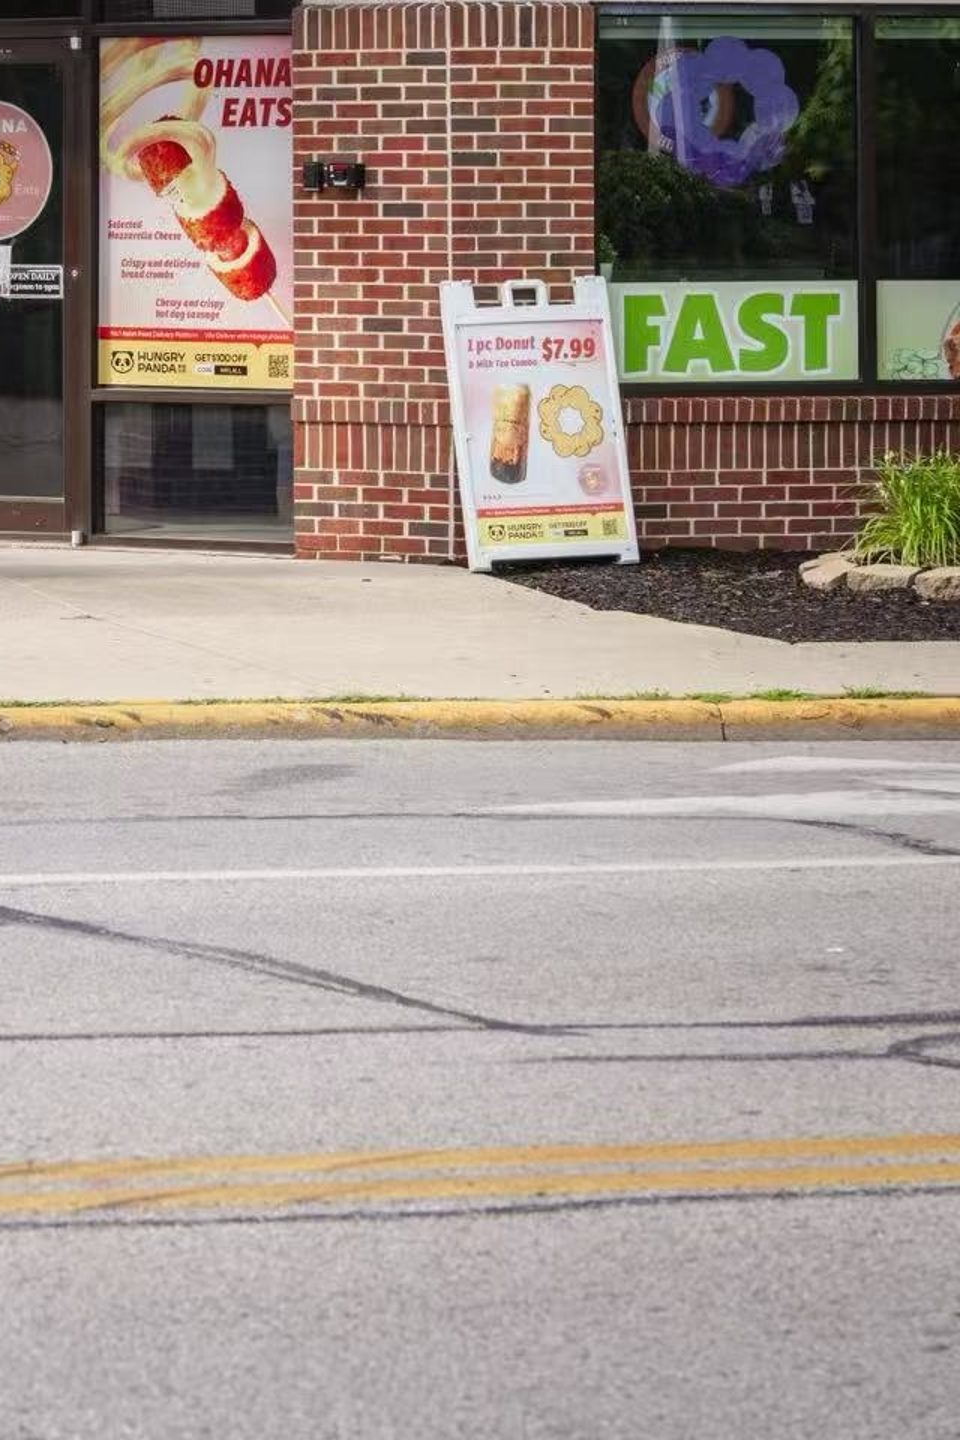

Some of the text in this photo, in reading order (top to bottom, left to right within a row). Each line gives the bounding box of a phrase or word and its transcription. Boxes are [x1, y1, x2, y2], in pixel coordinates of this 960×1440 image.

[193, 58, 292, 89] OHANA
[222, 97, 293, 127] EATS
[108, 219, 143, 229] Selected
[154, 231, 182, 241] Cheese
[121, 258, 146, 269] Crispy
[148, 259, 163, 268] and
[31, 272, 57, 281] DAILY
[200, 298, 225, 310] crispy
[623, 292, 841, 374] FAST
[476, 340, 492, 355] pc
[495, 336, 535, 351] Donut
[542, 336, 596, 362] $7.99
[137, 351, 186, 362] HUNGRY
[194, 353, 212, 362] GET
[137, 363, 177, 374] PANDA
